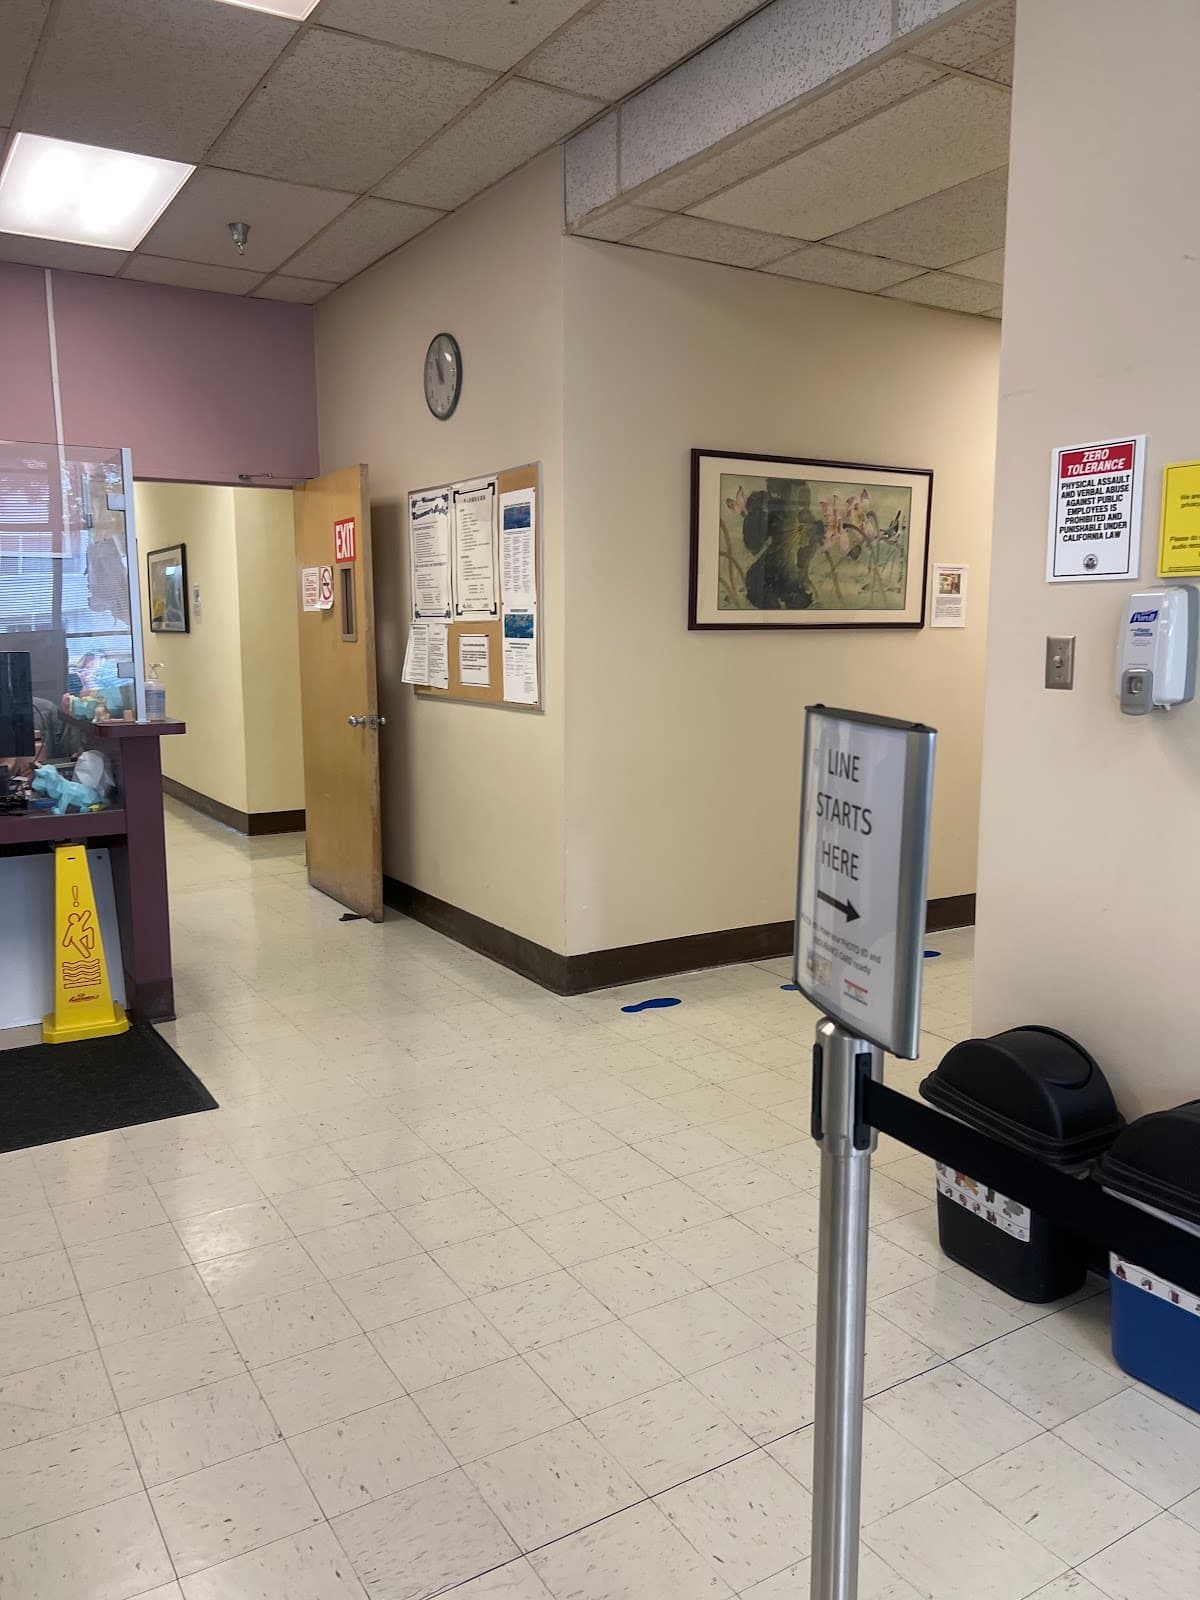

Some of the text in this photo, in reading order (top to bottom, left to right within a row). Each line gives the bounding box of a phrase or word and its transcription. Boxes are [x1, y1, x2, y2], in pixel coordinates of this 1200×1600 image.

[1082, 449, 1110, 462] ZERO
[1067, 458, 1126, 475] TOLERANCE
[1061, 475, 1130, 490] PHYSICAL ASSAULT
[1061, 484, 1130, 498] AND VERBAL ABUSE
[1066, 494, 1123, 507] AGAINST PUBLIC
[1067, 503, 1117, 515] EMPLOYEES IS
[1065, 512, 1123, 524] PROHIBITED AND
[1059, 521, 1128, 534] PUNISHABLE UNDER
[335, 523, 355, 560] EXIT
[1062, 530, 1121, 542] CALIFORNIA LAW
[828, 748, 860, 783] LINE
[816, 791, 873, 836] STARTS
[821, 842, 859, 881] HERE
